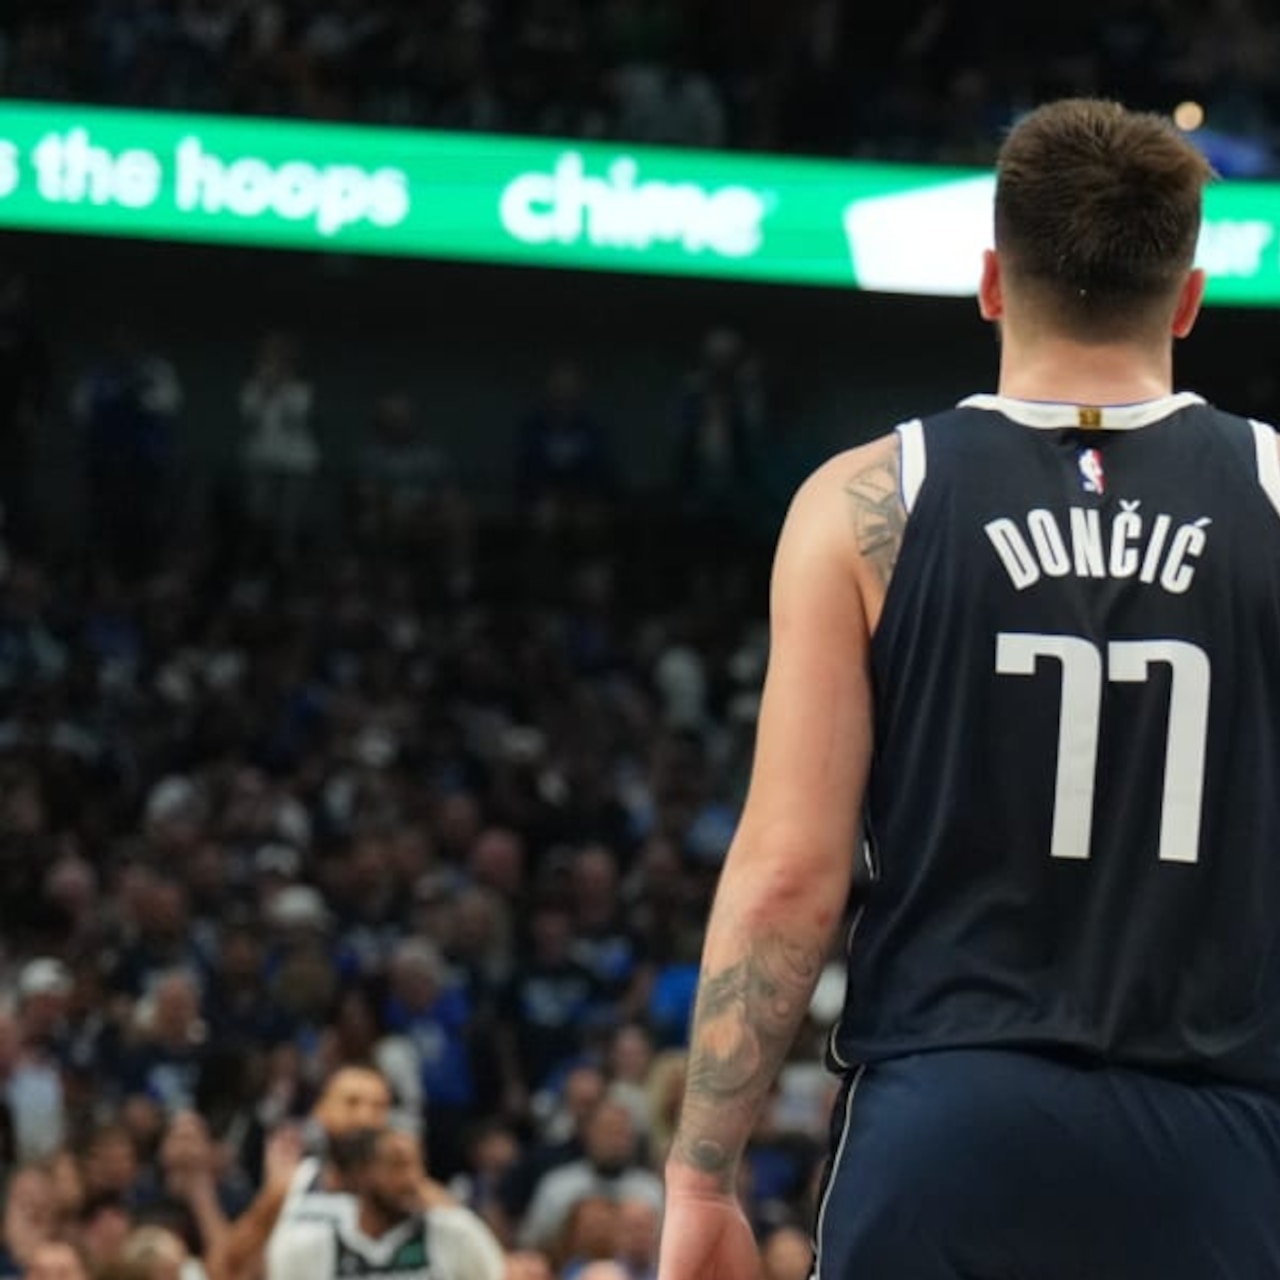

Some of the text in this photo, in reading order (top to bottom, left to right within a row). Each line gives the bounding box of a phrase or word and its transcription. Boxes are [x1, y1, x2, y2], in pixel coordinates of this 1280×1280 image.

[34, 130, 160, 206] the
[177, 138, 408, 233] hoops
[501, 154, 765, 255] chime
[984, 498, 1213, 594] DONČIĆ
[995, 632, 1211, 863] 77
